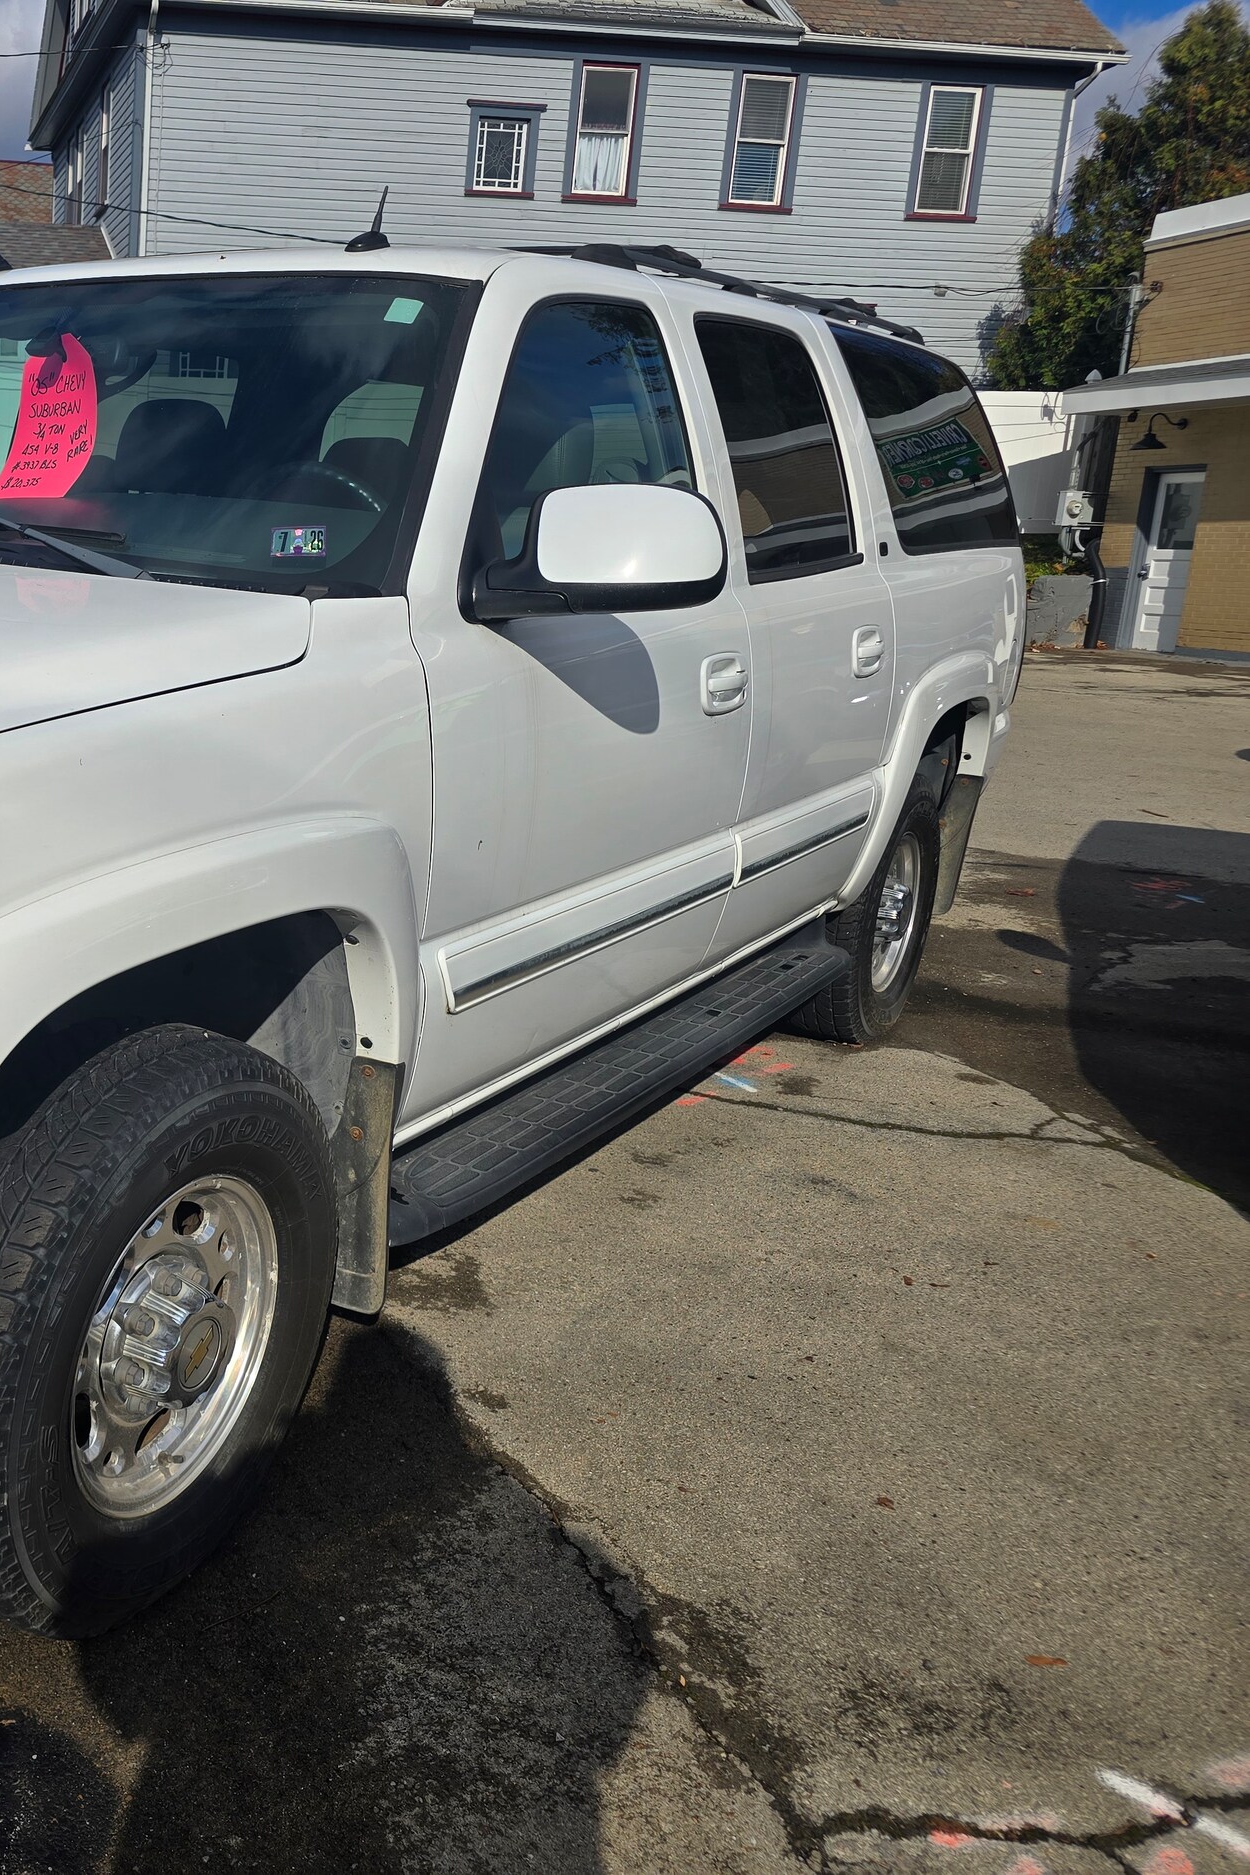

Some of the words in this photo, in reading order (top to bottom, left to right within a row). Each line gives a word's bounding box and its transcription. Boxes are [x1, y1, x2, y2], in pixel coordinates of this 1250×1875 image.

[56, 370, 86, 394] CHEVY
[29, 399, 81, 419] SUBURBAN
[49, 424, 65, 435] TON
[70, 419, 88, 445] VERY
[22, 444, 39, 455] 454
[45, 443, 58, 454] V-8
[310, 530, 324, 551] 26
[163, 1114, 323, 1201] YOKOHAMA
